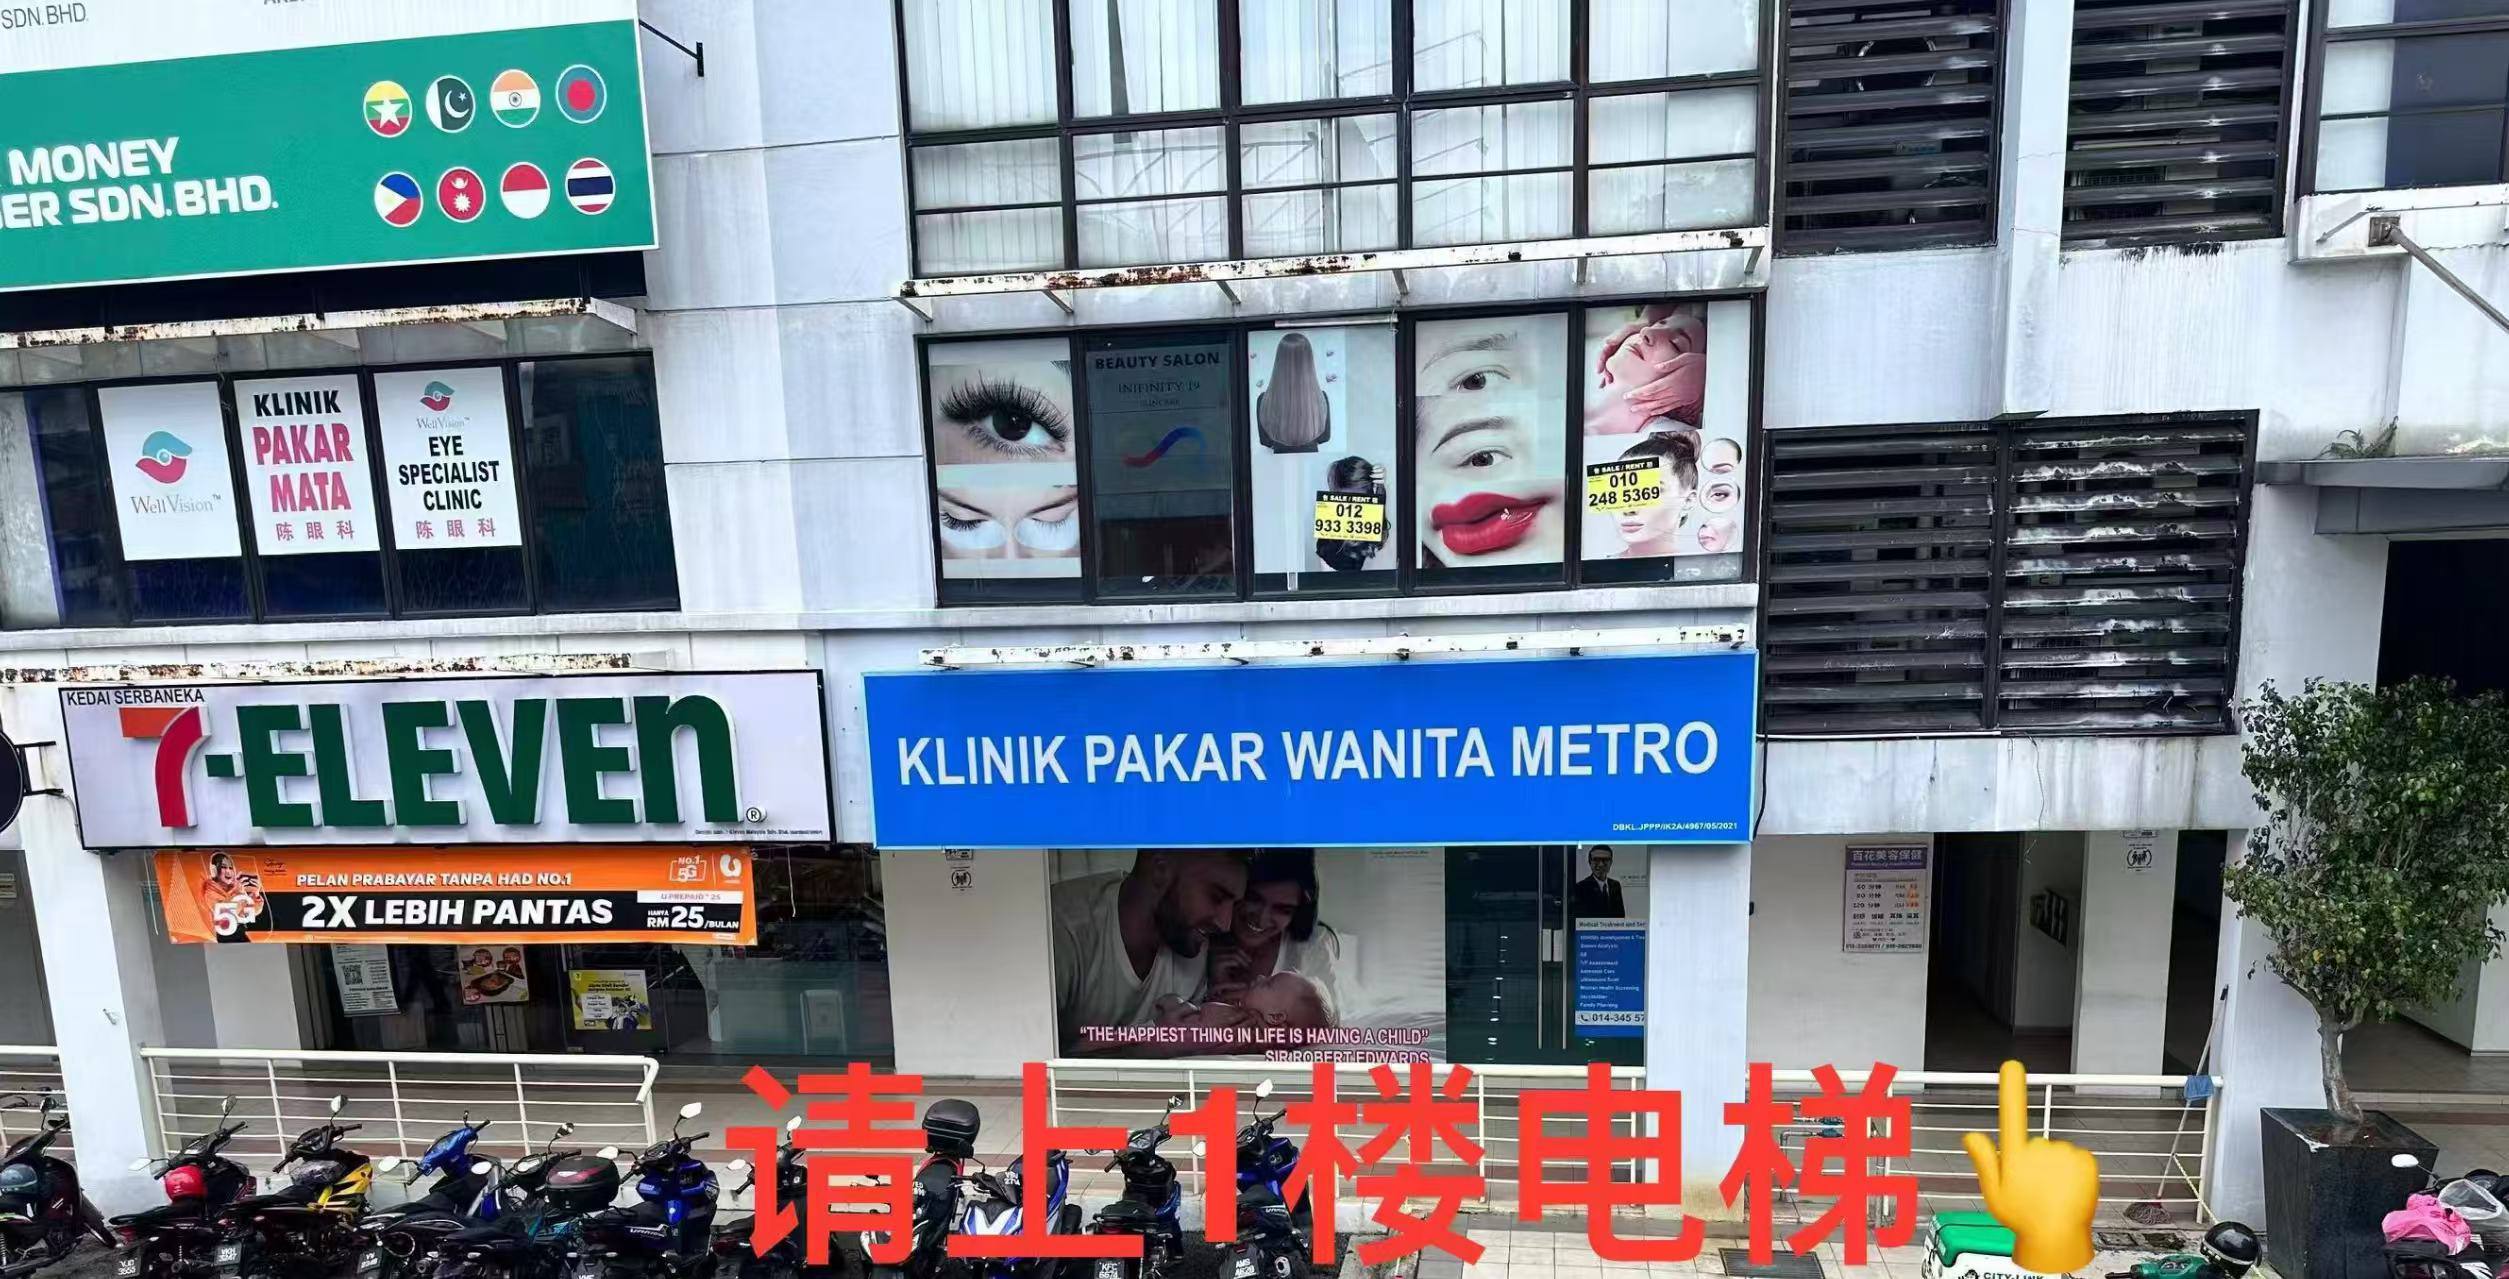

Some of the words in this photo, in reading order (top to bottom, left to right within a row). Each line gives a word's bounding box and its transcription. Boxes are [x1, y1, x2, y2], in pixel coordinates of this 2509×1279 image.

[8, 136, 180, 186] MONEY
[0, 191, 63, 230] ER
[1096, 356, 1158, 369] BEAUTY
[1163, 352, 1220, 367] SALON
[254, 390, 341, 417] KLINIK
[253, 423, 354, 465] PAKAR
[428, 435, 464, 457] EYE
[398, 460, 500, 485] SPECIALIST
[1602, 465, 1620, 473] SALE
[1625, 462, 1645, 471] RENT
[1610, 472, 1638, 488] 010
[270, 472, 352, 513] MATA
[423, 489, 482, 511] CLINIC
[1589, 491, 1617, 506] 248
[1622, 486, 1660, 502] 5369
[1336, 503, 1363, 518] 012
[1315, 519, 1341, 532] 933
[1346, 520, 1381, 534] 3398
[67, 691, 110, 706] KEDAI
[114, 688, 205, 705] SERBANEKA
[898, 735, 1070, 786] KLINIK
[1085, 731, 1267, 784] PAKAR
[1281, 726, 1495, 780] WANITA
[1512, 720, 1719, 777] METRO
[678, 855, 700, 865] NO.1
[297, 873, 348, 887] PELAN
[352, 873, 436, 887] PRABAYAR
[440, 872, 493, 886] TANPA
[497, 872, 533, 886] HAD
[536, 872, 572, 886] NO.1
[678, 865, 698, 882] 5G
[213, 894, 256, 936] 5G
[302, 895, 357, 928] 2X
[365, 899, 463, 925] LEBIH
[472, 899, 613, 925] PANTAS
[647, 917, 669, 928] RM
[671, 906, 704, 928] 25
[704, 920, 739, 929] /BULAN
[1592, 1013, 1632, 1022] 014-345
[1118, 1026, 1187, 1042] HAPPIEST
[1190, 1026, 1233, 1043] THING
[1237, 1027, 1251, 1043] IN
[1255, 1027, 1285, 1044] LIFE
[1289, 1027, 1303, 1044] IS
[1306, 1028, 1360, 1045] HAVING
[1363, 1028, 1374, 1044] A
[1264, 1050, 1289, 1063] SIR
[1292, 1050, 1352, 1063] ROBERT
[1355, 1051, 1431, 1064] EDWARDS
[1102, 1263, 1117, 1271] KFC
